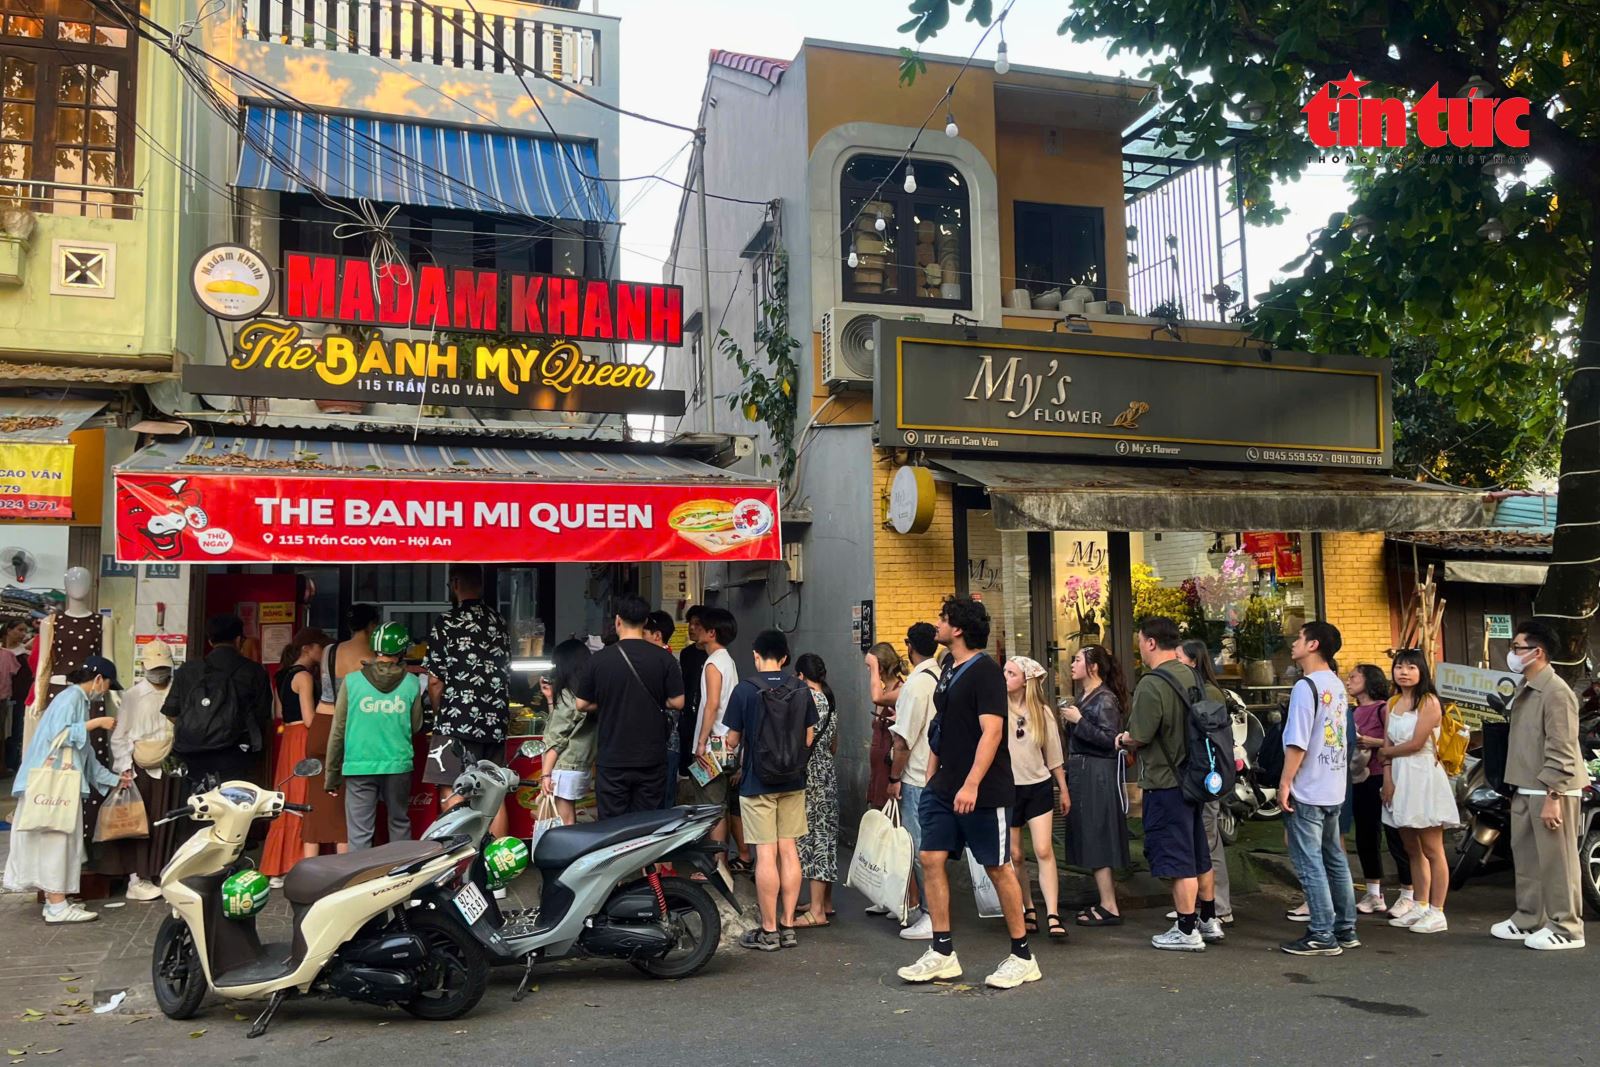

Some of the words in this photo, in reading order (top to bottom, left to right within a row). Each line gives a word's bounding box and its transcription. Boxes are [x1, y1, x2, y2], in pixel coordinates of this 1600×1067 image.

[201, 252, 234, 275] Madam
[237, 252, 264, 280] Khanh
[287, 254, 497, 331] MADAM
[511, 274, 684, 342] KHANH
[231, 322, 317, 370] The
[315, 333, 457, 385] BÁNH
[541, 341, 654, 393] Queen
[357, 379, 381, 391] 115
[431, 383, 460, 396] CAO
[466, 382, 495, 397] VÂN
[963, 355, 1072, 418] My's
[1034, 408, 1102, 424] FLOWER
[924, 433, 937, 444] 117
[962, 435, 980, 446] Cao
[31, 469, 62, 480] VÂN
[29, 501, 57, 510] 971
[255, 497, 334, 526] THE
[345, 500, 463, 527] BANH
[474, 501, 520, 528] MI
[529, 502, 653, 533] QUEEN
[279, 535, 304, 545] 115
[340, 535, 367, 546] Cao
[372, 534, 397, 546] Vân
[408, 536, 430, 548] Hội
[432, 536, 452, 546] An
[397, 634, 410, 646] Grab
[359, 695, 406, 714] Grab
